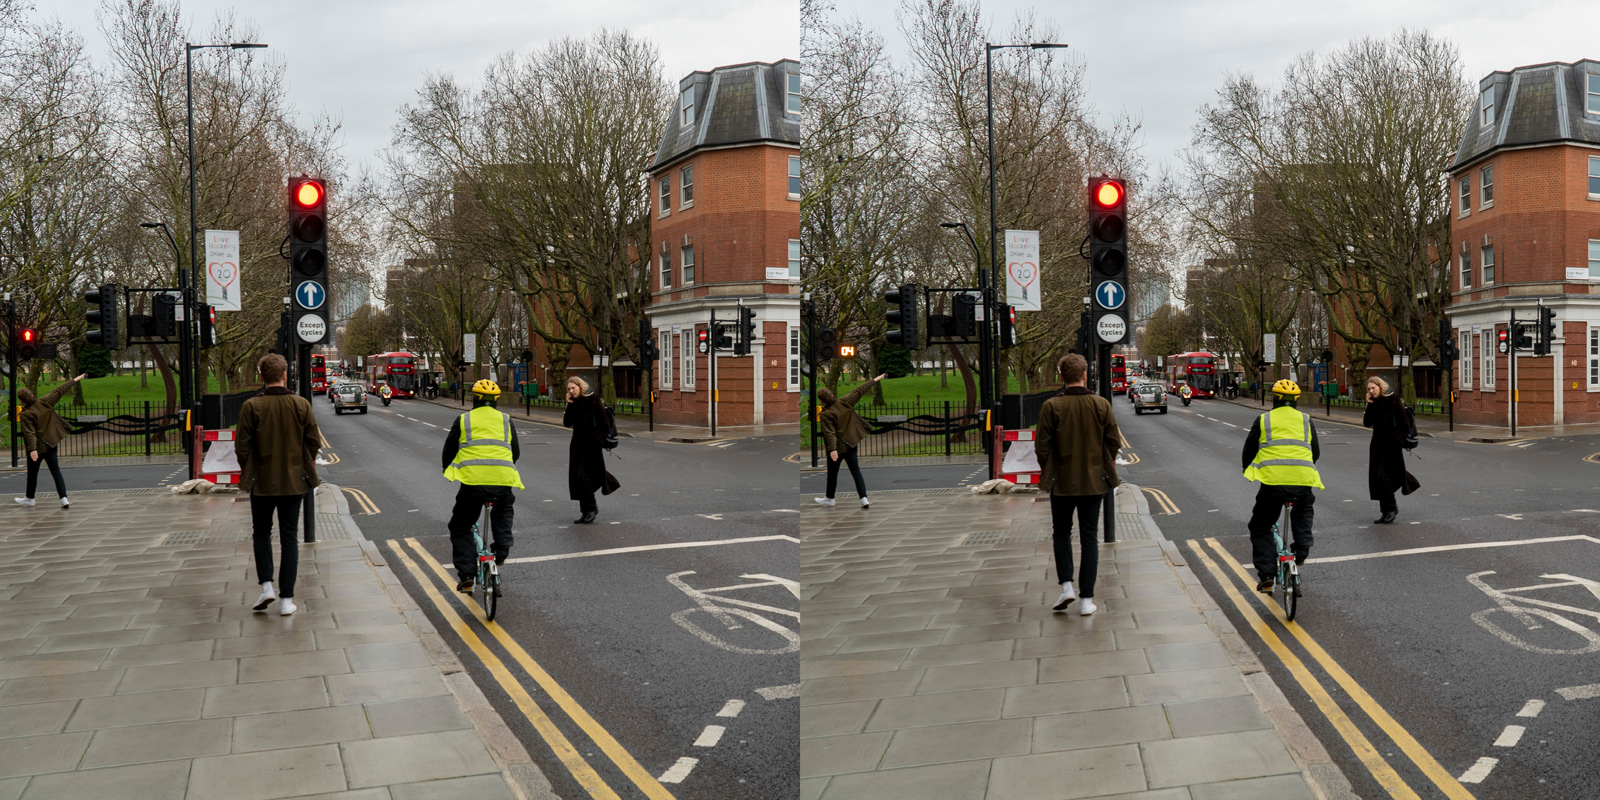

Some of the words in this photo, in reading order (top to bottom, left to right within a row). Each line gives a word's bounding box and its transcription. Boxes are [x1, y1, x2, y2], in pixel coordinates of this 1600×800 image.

[217, 269, 231, 278] 20
[1017, 269, 1031, 278] 20
[299, 321, 324, 329] Except
[1099, 321, 1124, 329] Except
[841, 346, 854, 356] 04
